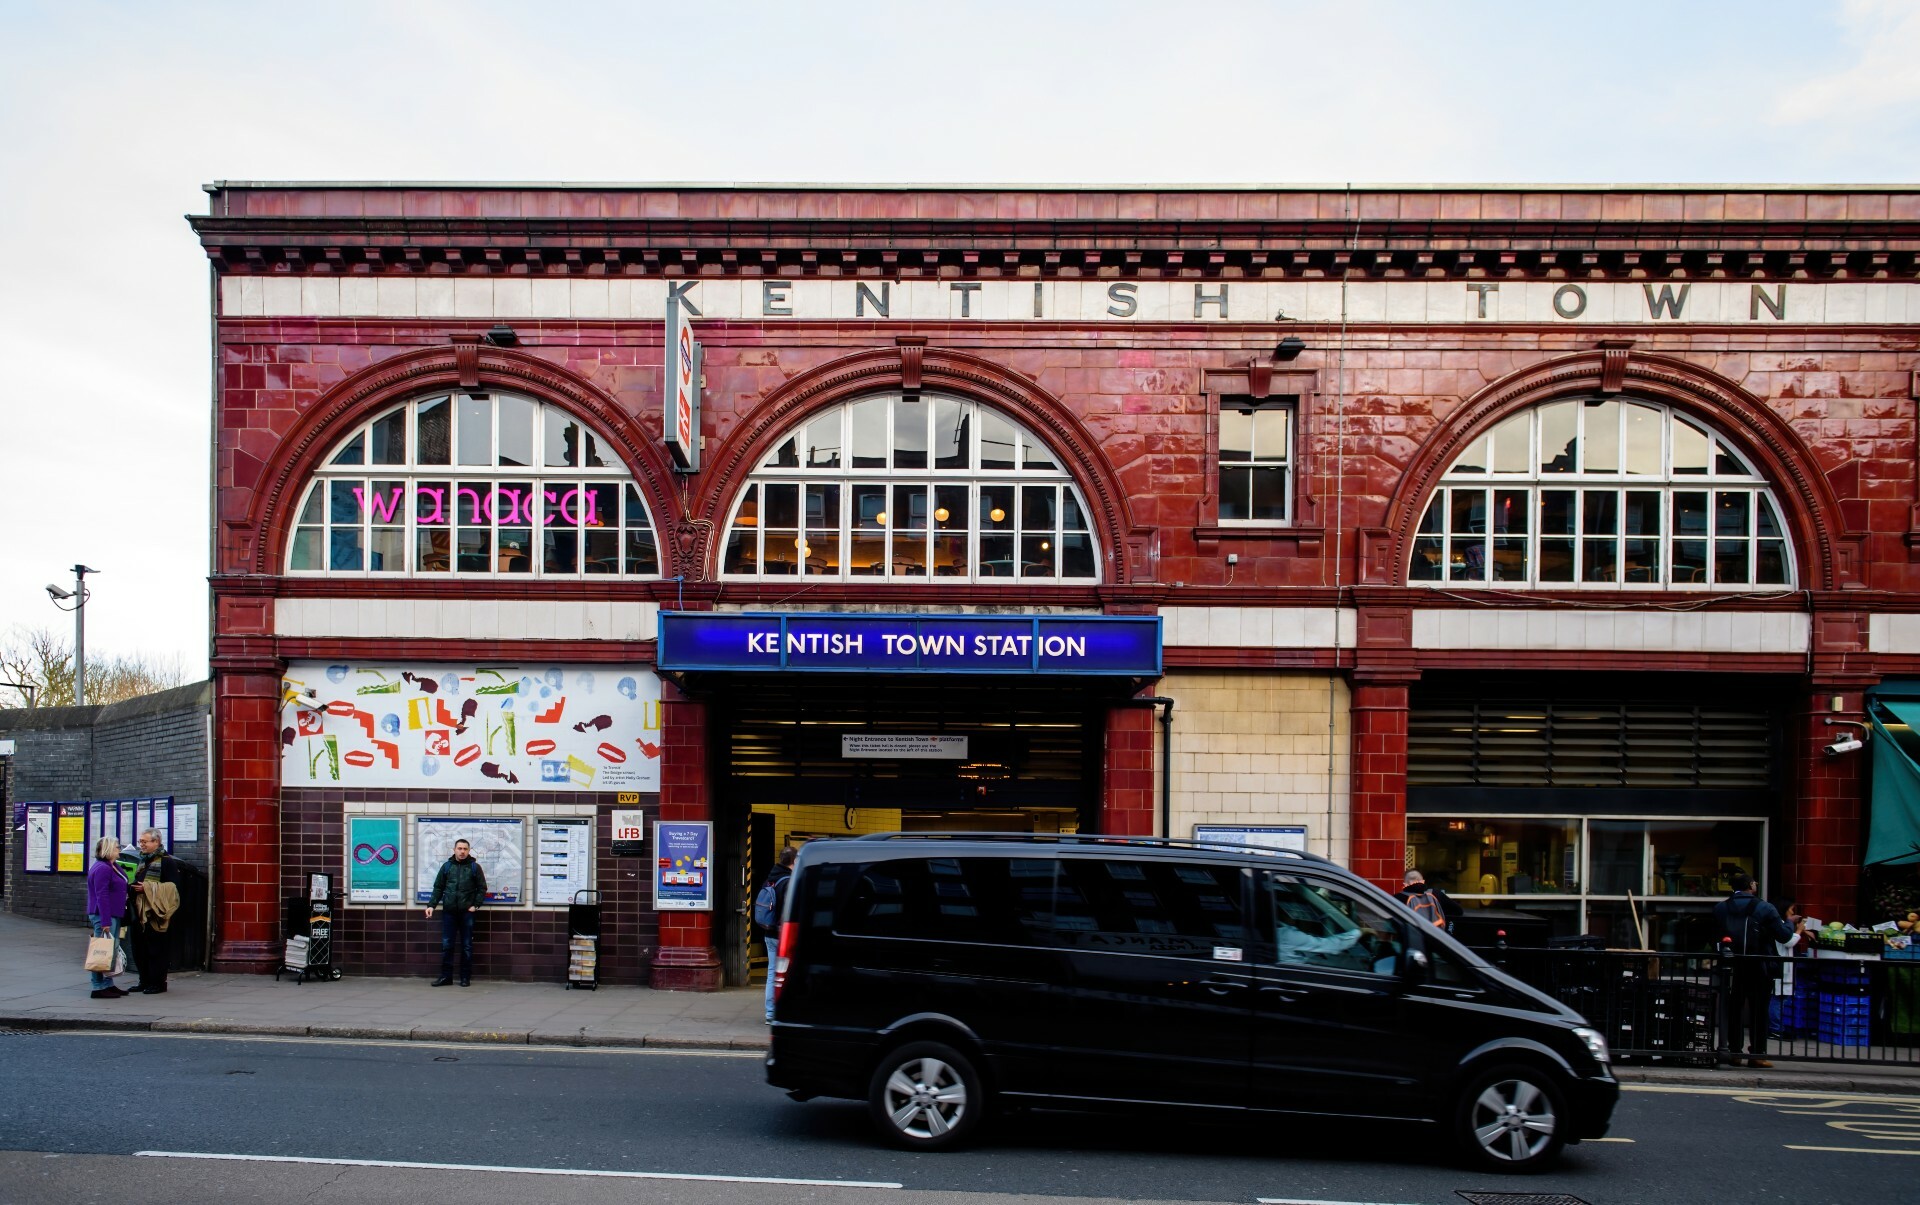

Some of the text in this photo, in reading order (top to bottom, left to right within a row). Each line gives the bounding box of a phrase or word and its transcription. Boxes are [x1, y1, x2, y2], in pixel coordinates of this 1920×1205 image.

[669, 281, 1787, 320] KENTISH TOWN
[748, 633, 1086, 657] KENTISH TOWN STATION
[620, 794, 638, 802] RVP
[618, 827, 640, 839] LFB
[312, 928, 329, 936] FREE
